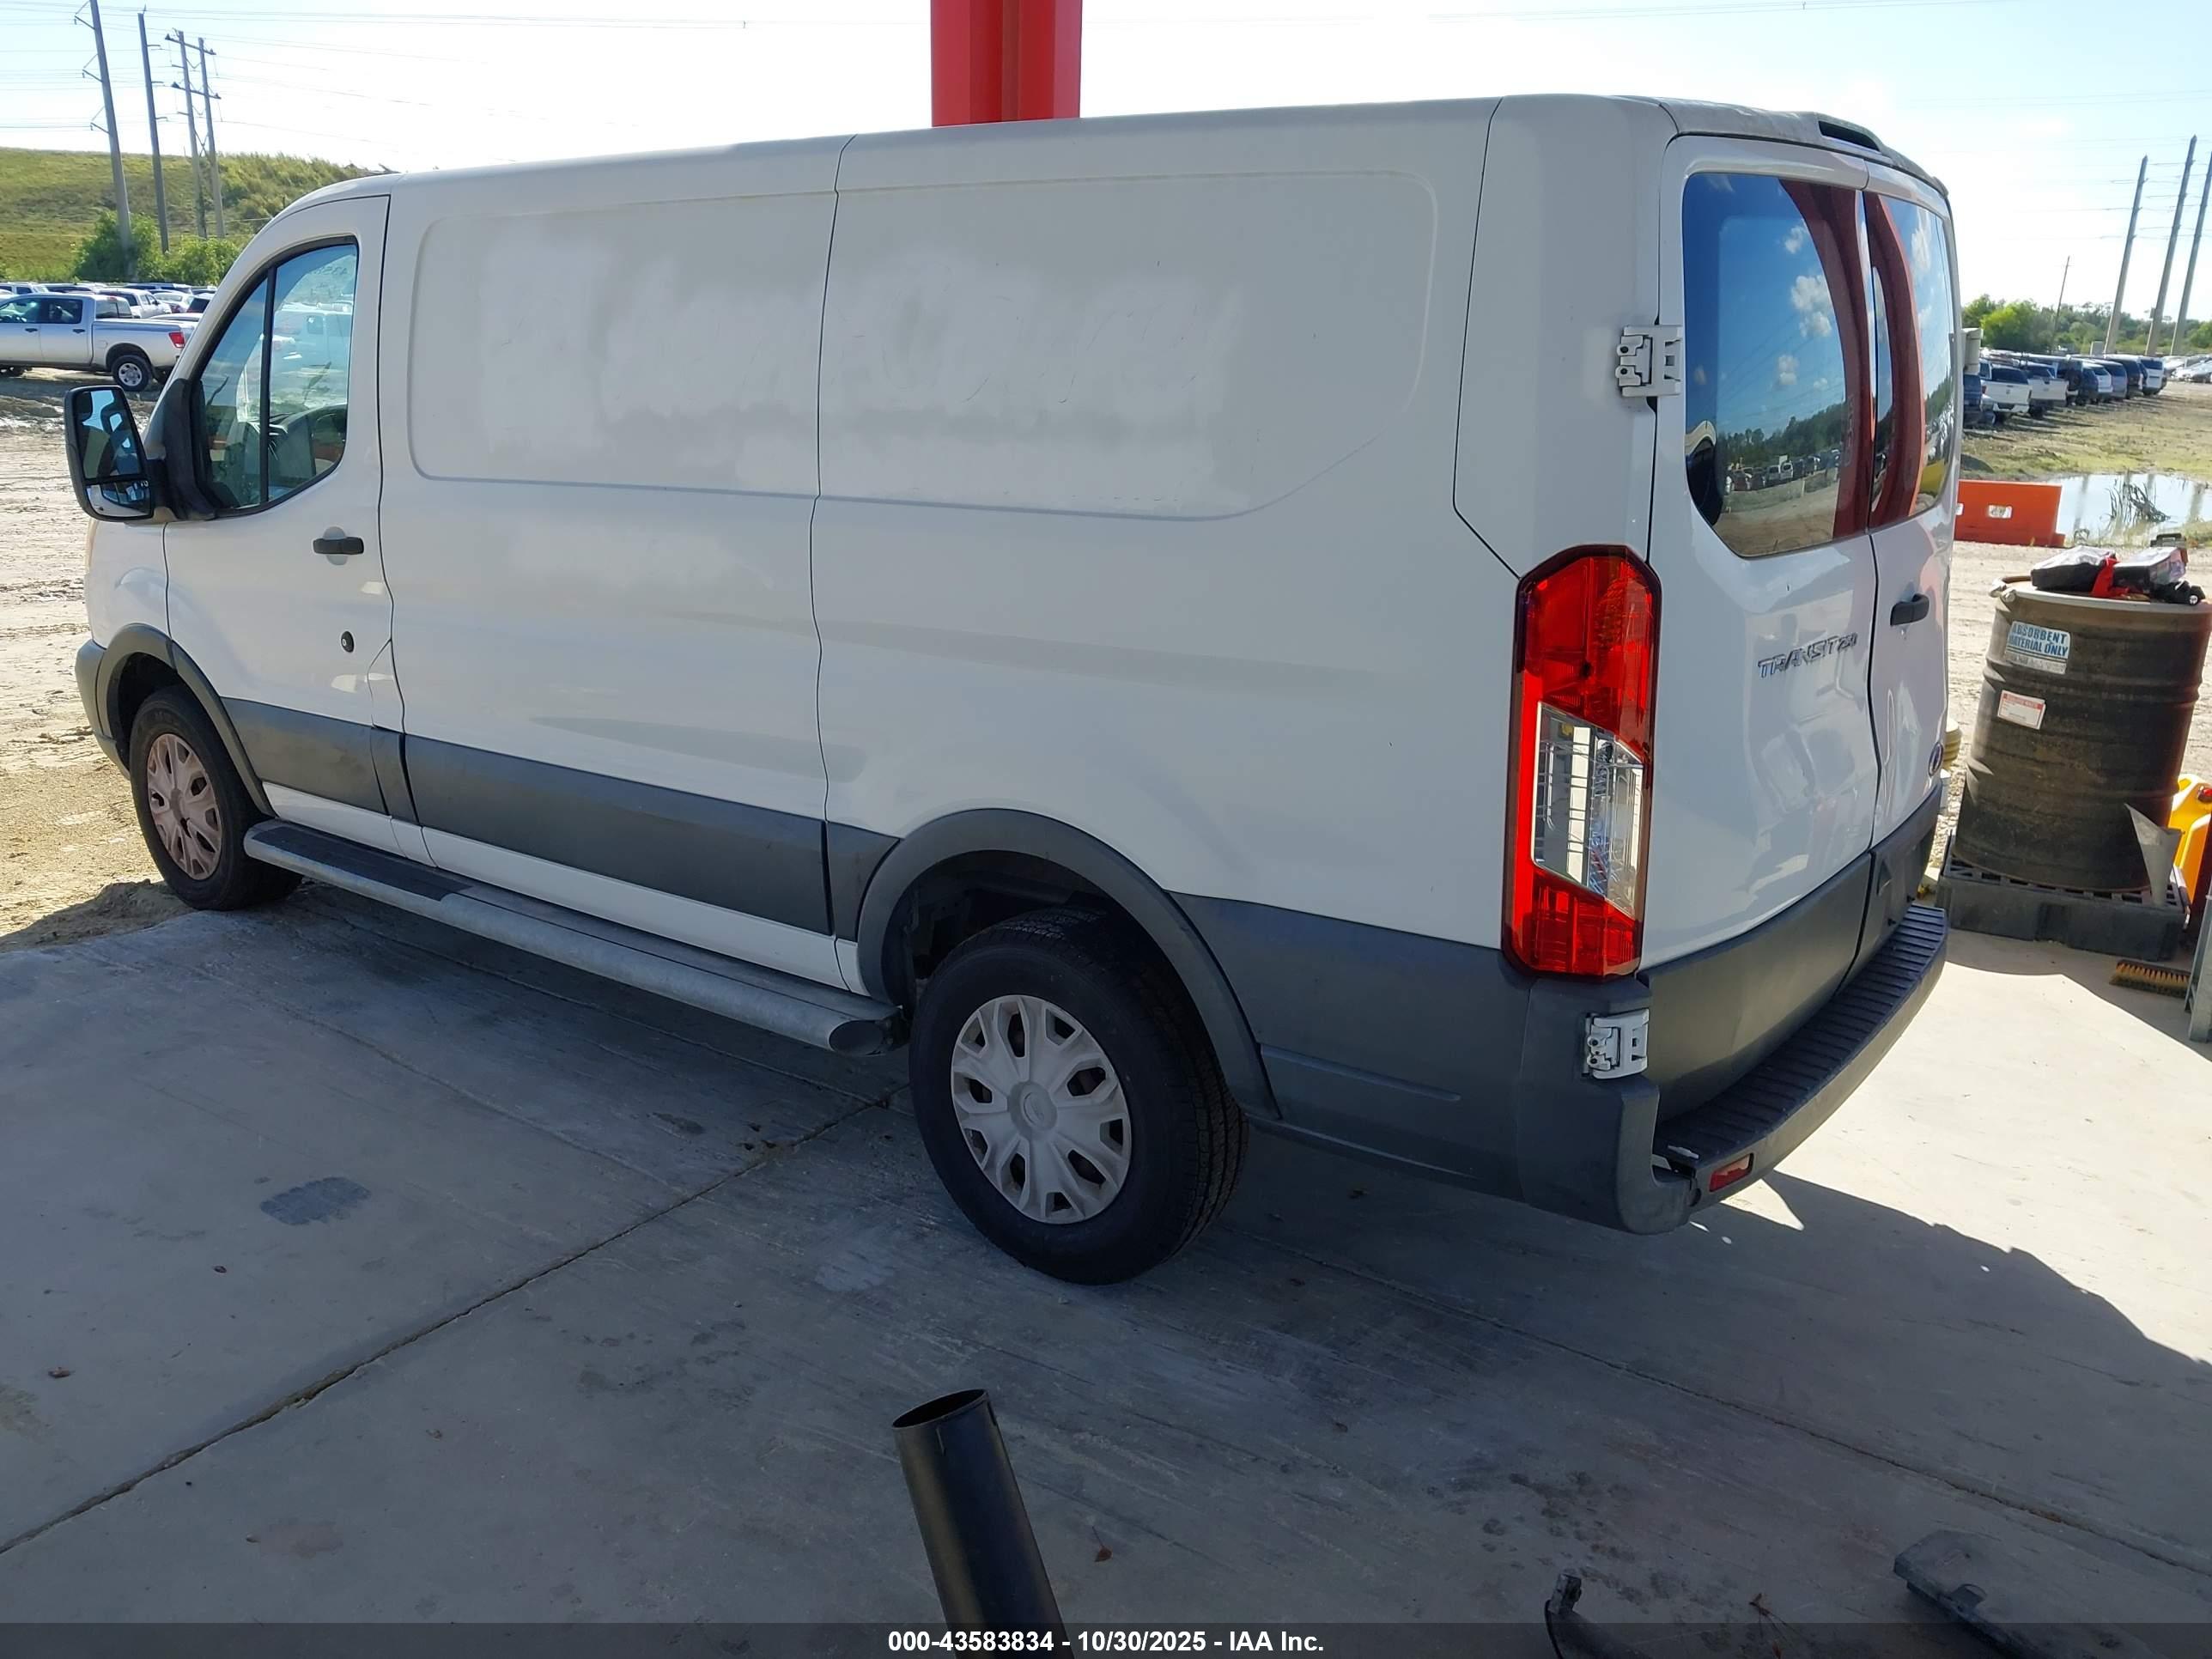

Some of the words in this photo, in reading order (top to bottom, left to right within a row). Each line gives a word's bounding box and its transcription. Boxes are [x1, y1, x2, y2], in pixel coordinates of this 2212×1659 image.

[2011, 623, 2068, 644] ABSORBENT
[2008, 634, 2043, 653] MATERIAL
[2044, 642, 2069, 656] ONLY
[1758, 635, 1838, 678] TRANSIT
